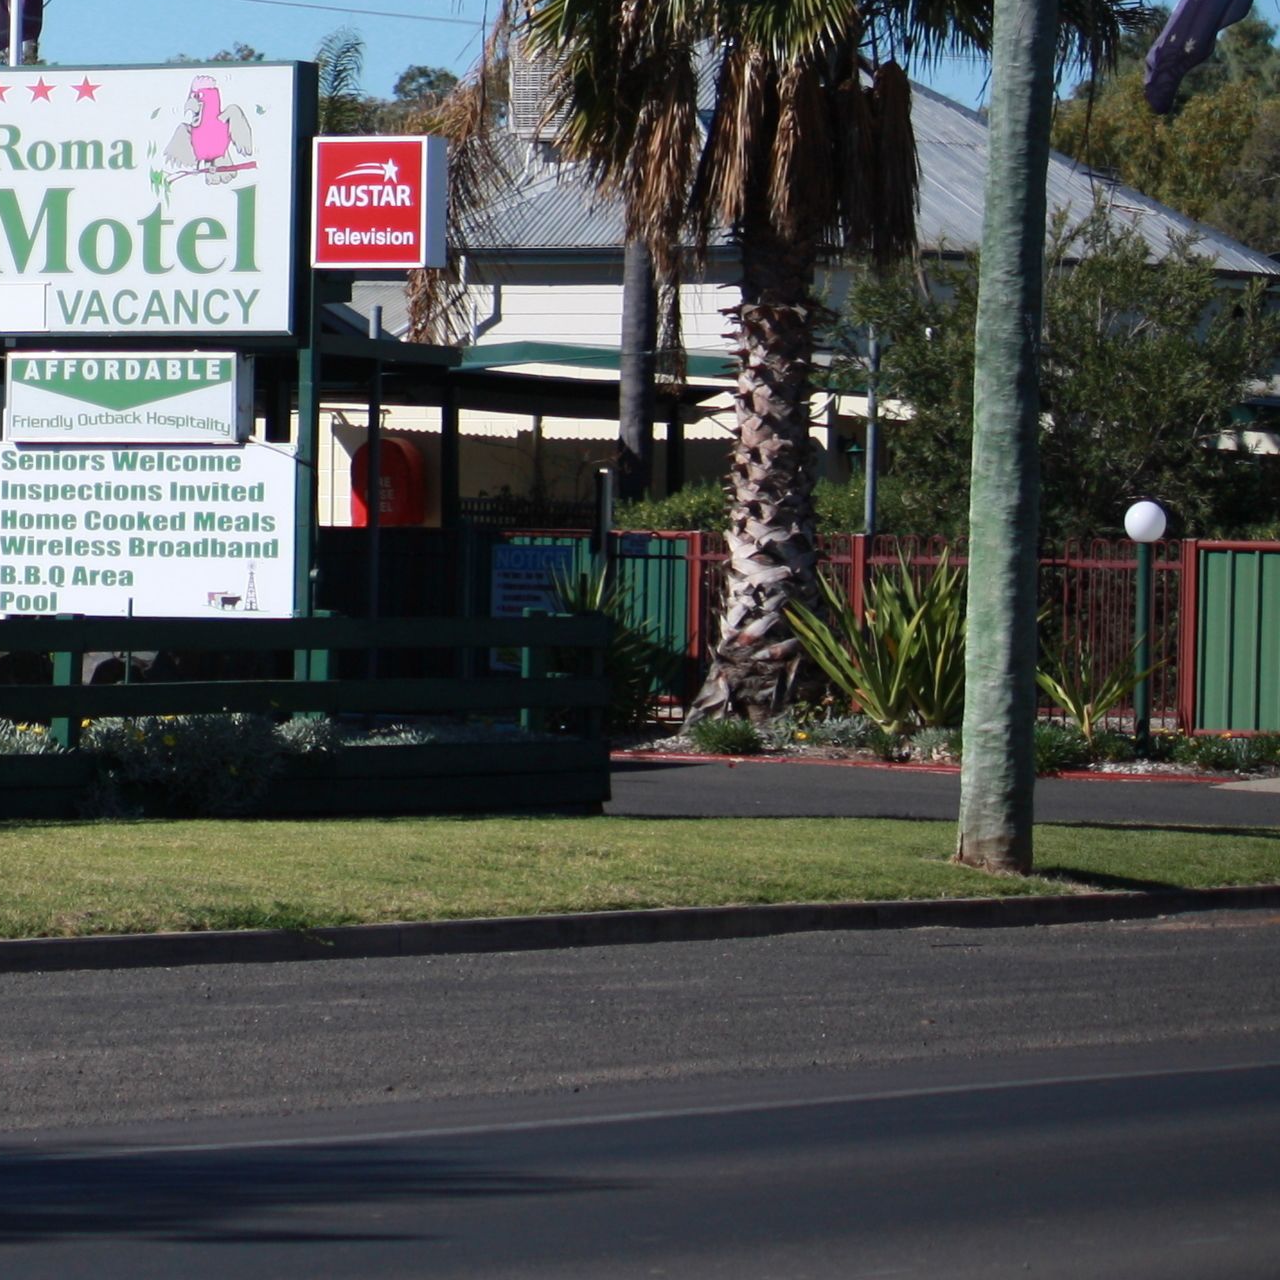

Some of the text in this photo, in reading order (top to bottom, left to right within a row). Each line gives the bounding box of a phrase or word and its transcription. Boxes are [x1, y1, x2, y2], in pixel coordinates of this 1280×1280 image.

[324, 185, 411, 207] AUSTAR
[324, 227, 414, 245] Television
[56, 287, 260, 325] VACANCY
[23, 359, 221, 381] AFFORDABLE
[12, 411, 231, 436] Friendly Outback Hospitality
[1, 450, 241, 472] Seniors Welcome
[1, 480, 264, 502] Inspections Invited
[1, 510, 276, 532] Home Cooked Meals
[0, 536, 278, 559] Wireless Broadband
[496, 549, 568, 569] NOTICE
[0, 565, 133, 587] B.B.Q Area
[0, 591, 57, 612] Pool
